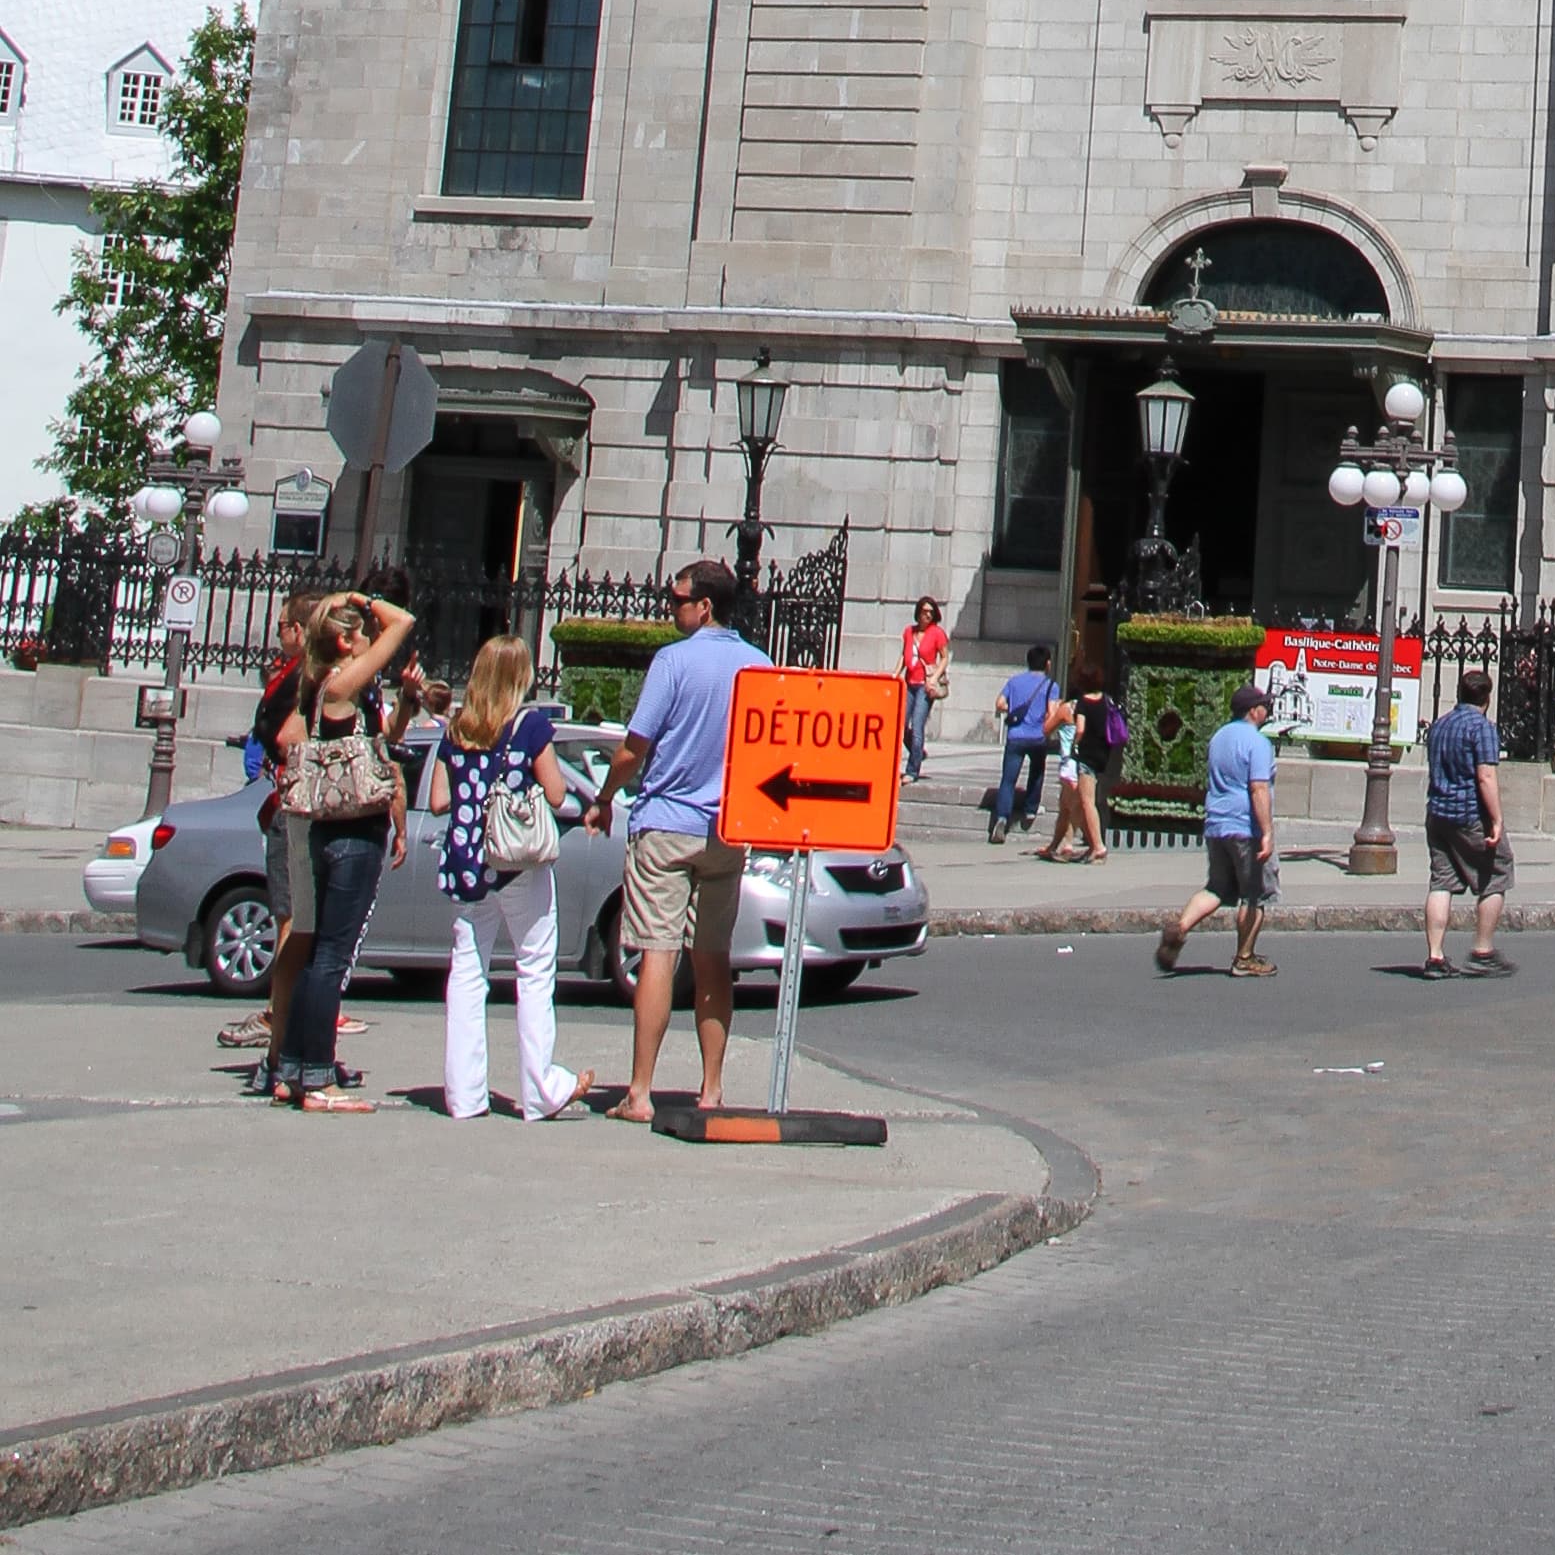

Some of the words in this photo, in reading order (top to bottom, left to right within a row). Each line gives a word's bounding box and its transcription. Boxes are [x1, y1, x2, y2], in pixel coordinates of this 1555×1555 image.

[1284, 636, 1381, 651] Basilique-Cathédra
[1313, 658, 1363, 670] Notre-Dame
[1366, 663, 1377, 672] de
[744, 699, 884, 750] DÉTOUR
